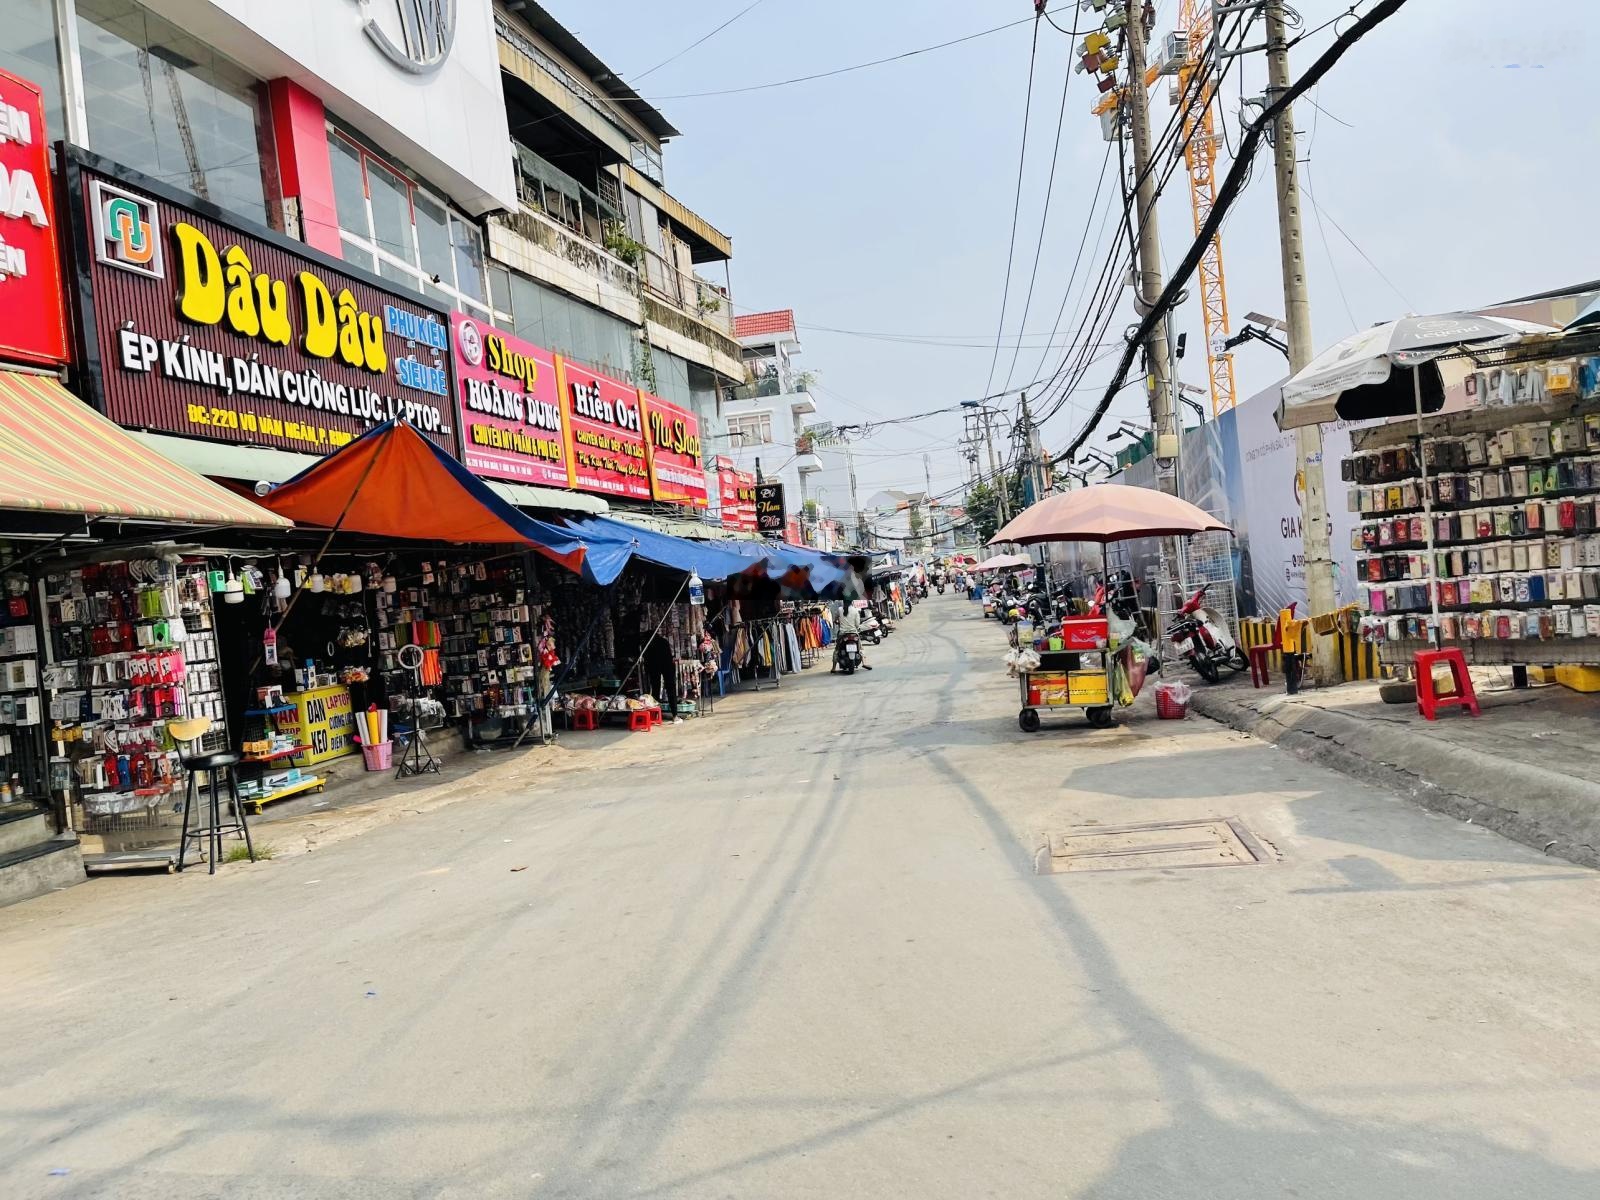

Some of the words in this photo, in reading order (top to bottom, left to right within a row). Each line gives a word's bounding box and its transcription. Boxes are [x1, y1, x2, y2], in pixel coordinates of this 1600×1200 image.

[175, 222, 291, 346] Dâu
[300, 271, 387, 374] Dâu
[386, 305, 416, 348] PHỤ
[418, 315, 448, 355] KIỆN
[120, 320, 158, 372] ÉP
[161, 335, 232, 395] KÍNH,
[233, 353, 281, 399] DÁN
[282, 369, 349, 414] CƯỜNG
[397, 355, 428, 390] SIÊU
[430, 359, 448, 395] RẺ
[488, 333, 538, 392] Shop
[187, 404, 210, 425] ĐC:
[211, 407, 238, 429] 220
[239, 411, 257, 432] VÕ
[258, 415, 283, 437] VĂN
[285, 421, 319, 446] NGÂN,
[468, 378, 523, 421] HOÀNG
[527, 398, 561, 431] DUNG
[574, 380, 614, 423] Hiền
[616, 398, 641, 431] Ori
[674, 417, 701, 461] Shop
[757, 501, 781, 513] Nam
[1281, 518, 1297, 539] GIA
[306, 694, 327, 724] DÁN
[325, 693, 350, 709] LAPTOP
[311, 729, 328, 755] KEO
